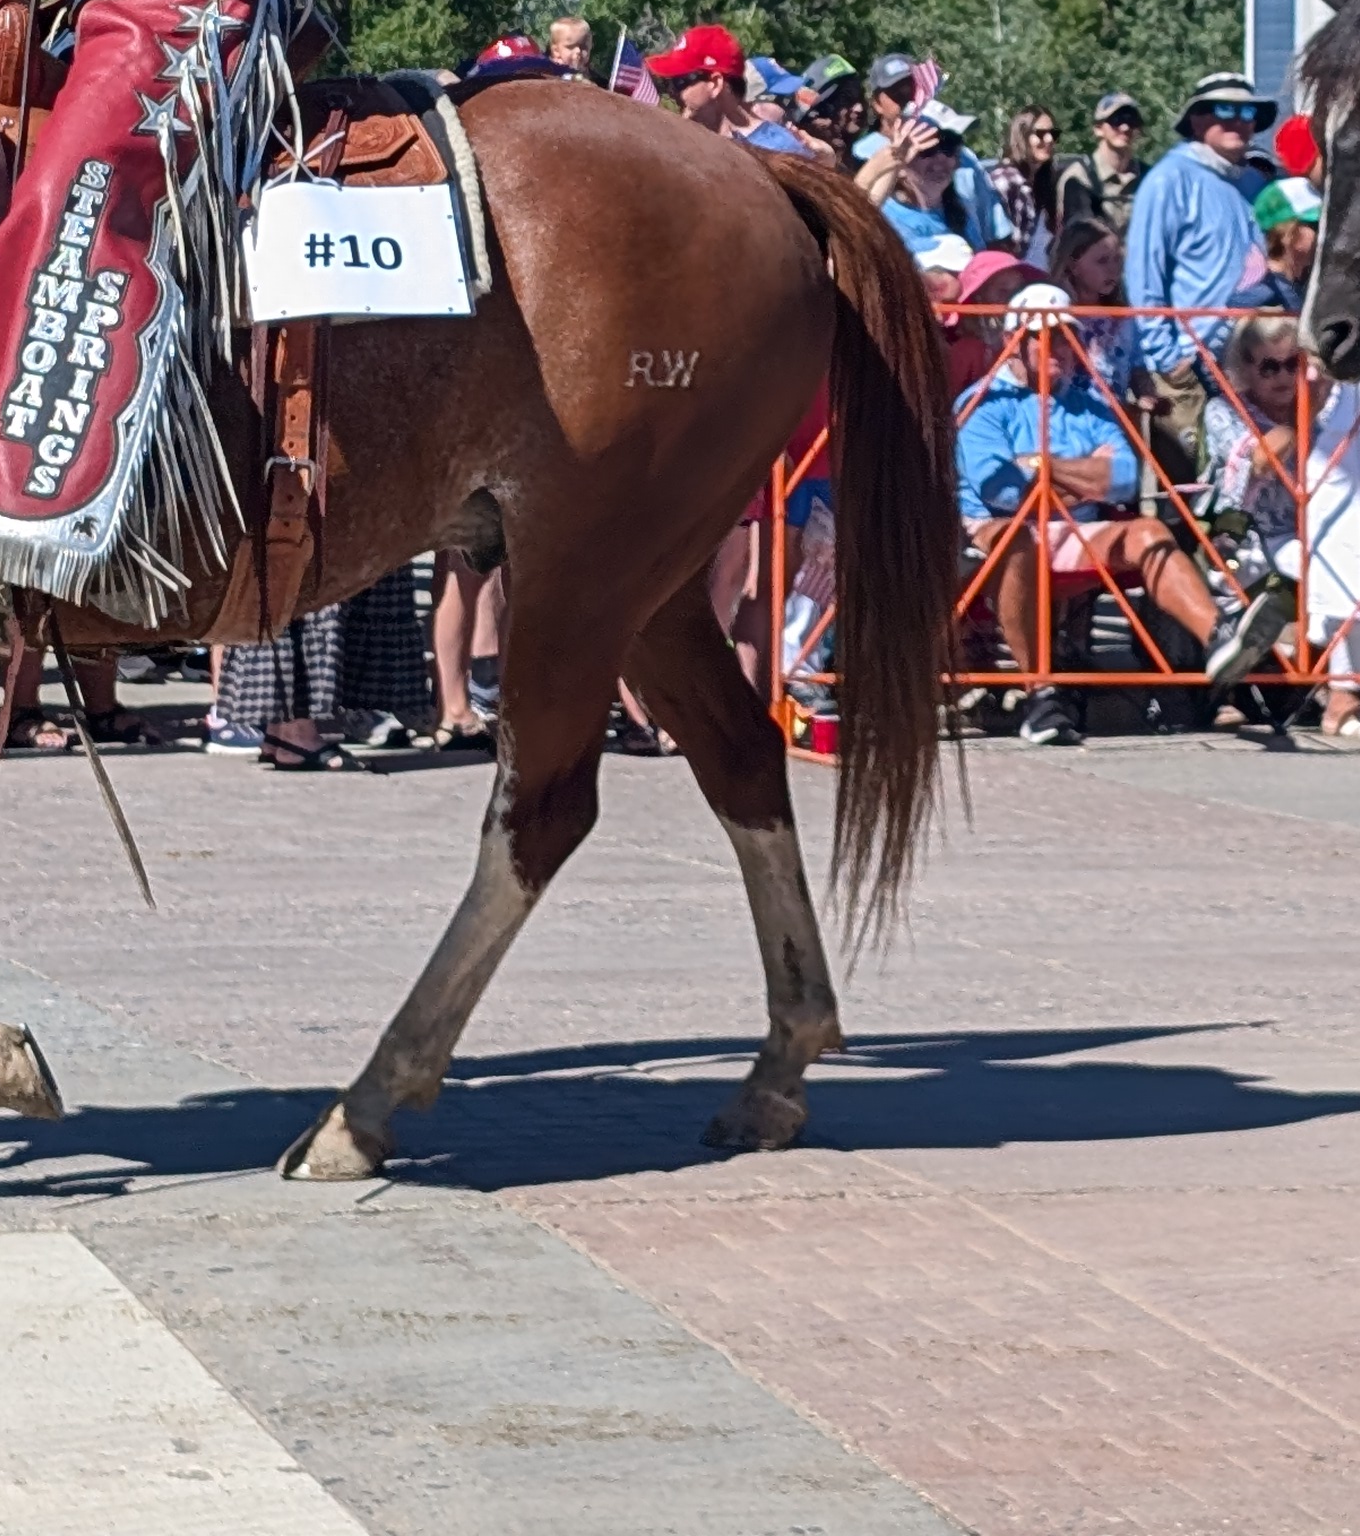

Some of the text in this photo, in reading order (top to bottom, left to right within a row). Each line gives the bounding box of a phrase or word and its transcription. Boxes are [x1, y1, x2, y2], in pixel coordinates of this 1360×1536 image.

[3, 159, 110, 439] STEAMBOAT
[304, 232, 403, 271] #10
[26, 269, 126, 495] SPRINGS
